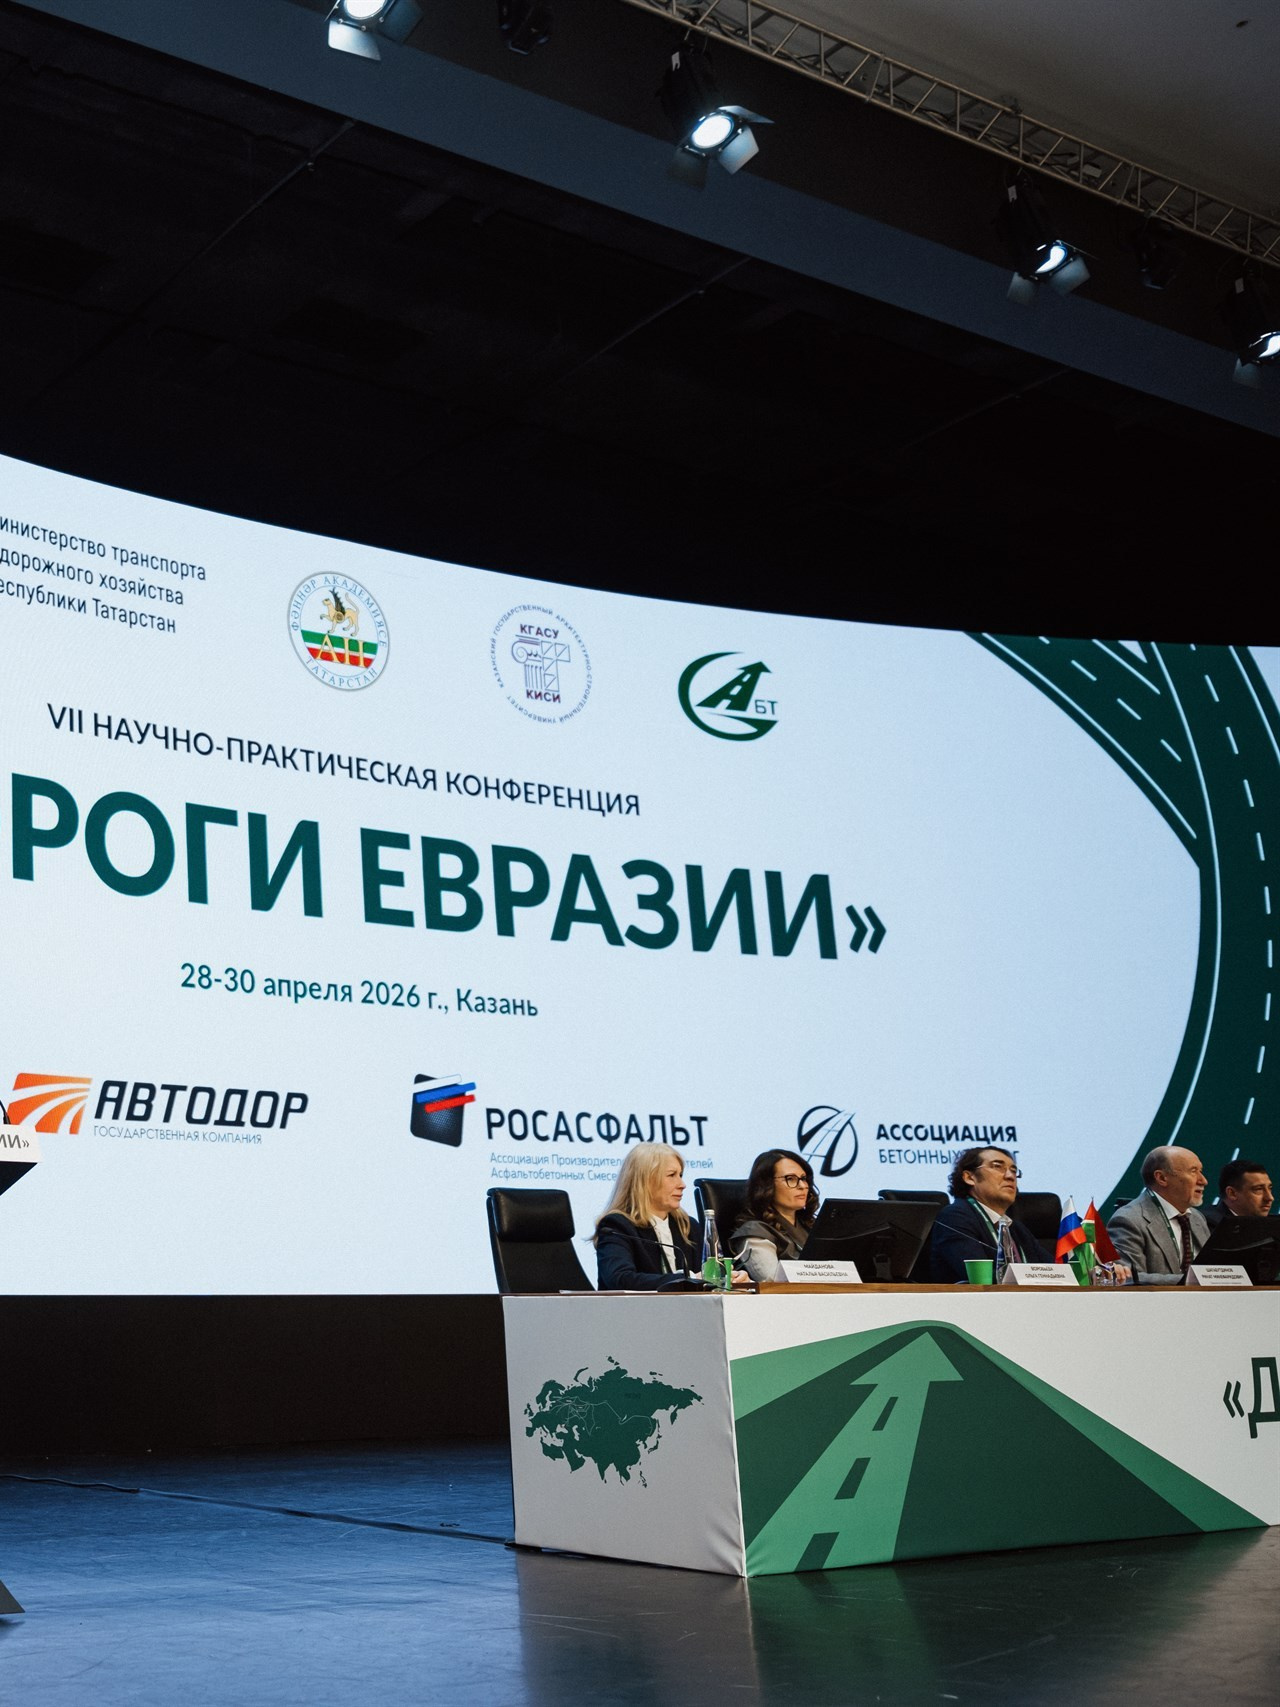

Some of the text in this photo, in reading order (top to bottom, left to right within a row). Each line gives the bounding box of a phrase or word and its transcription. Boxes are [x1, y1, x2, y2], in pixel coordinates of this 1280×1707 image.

[0, 546, 94, 586] дорожного
[99, 572, 184, 605] хозяйства
[111, 545, 206, 581] транспорта
[92, 598, 176, 634] Татарстан
[519, 623, 560, 639] КГАСУ
[305, 655, 378, 688] ТАТАРСТАН
[526, 689, 562, 704] КИСИ
[47, 703, 641, 817] VII НАУЧНО-ПРАКТИЧЕСКАЯ КОНФЕРЕНЦИЯ
[360, 827, 888, 960] ЕВРАЗИИ»
[180, 962, 539, 1017] 28-30 апреля 2026 г., Казань
[94, 1080, 309, 1130] АВТОДОР
[94, 1125, 263, 1145] ГОСУДАРСТВЕННАЯ КОМПАНИЯ
[485, 1107, 709, 1147] РОСАСФАЛЬТ
[876, 1123, 1018, 1145] АССОЦИАЦИЯ
[490, 1152, 714, 1169] Ассоциация Производител телей
[491, 1167, 617, 1182] Асфальтобетонных Смесе
